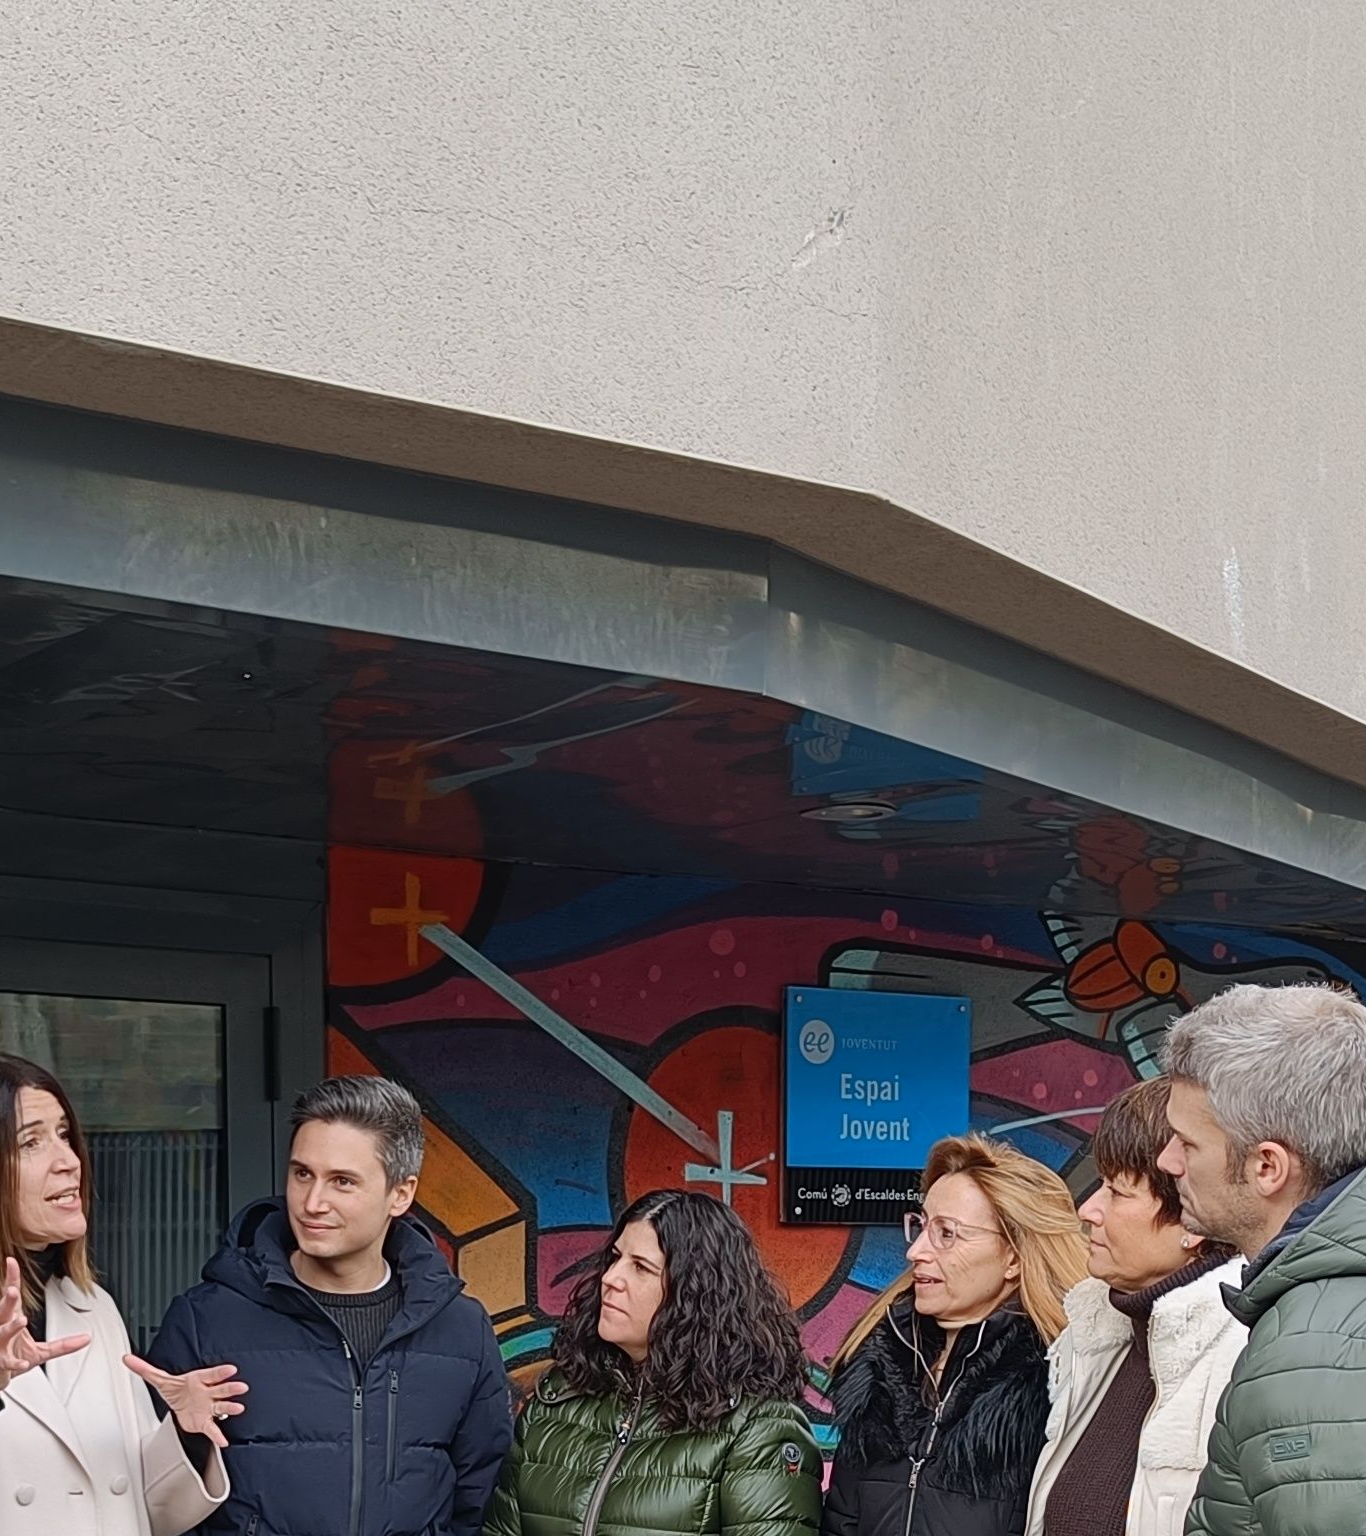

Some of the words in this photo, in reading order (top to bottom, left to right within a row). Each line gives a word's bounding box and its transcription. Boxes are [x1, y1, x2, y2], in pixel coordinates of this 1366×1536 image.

[840, 1073, 899, 1106] Espai
[839, 1113, 910, 1141] Jovent
[797, 1187, 828, 1200] Comú
